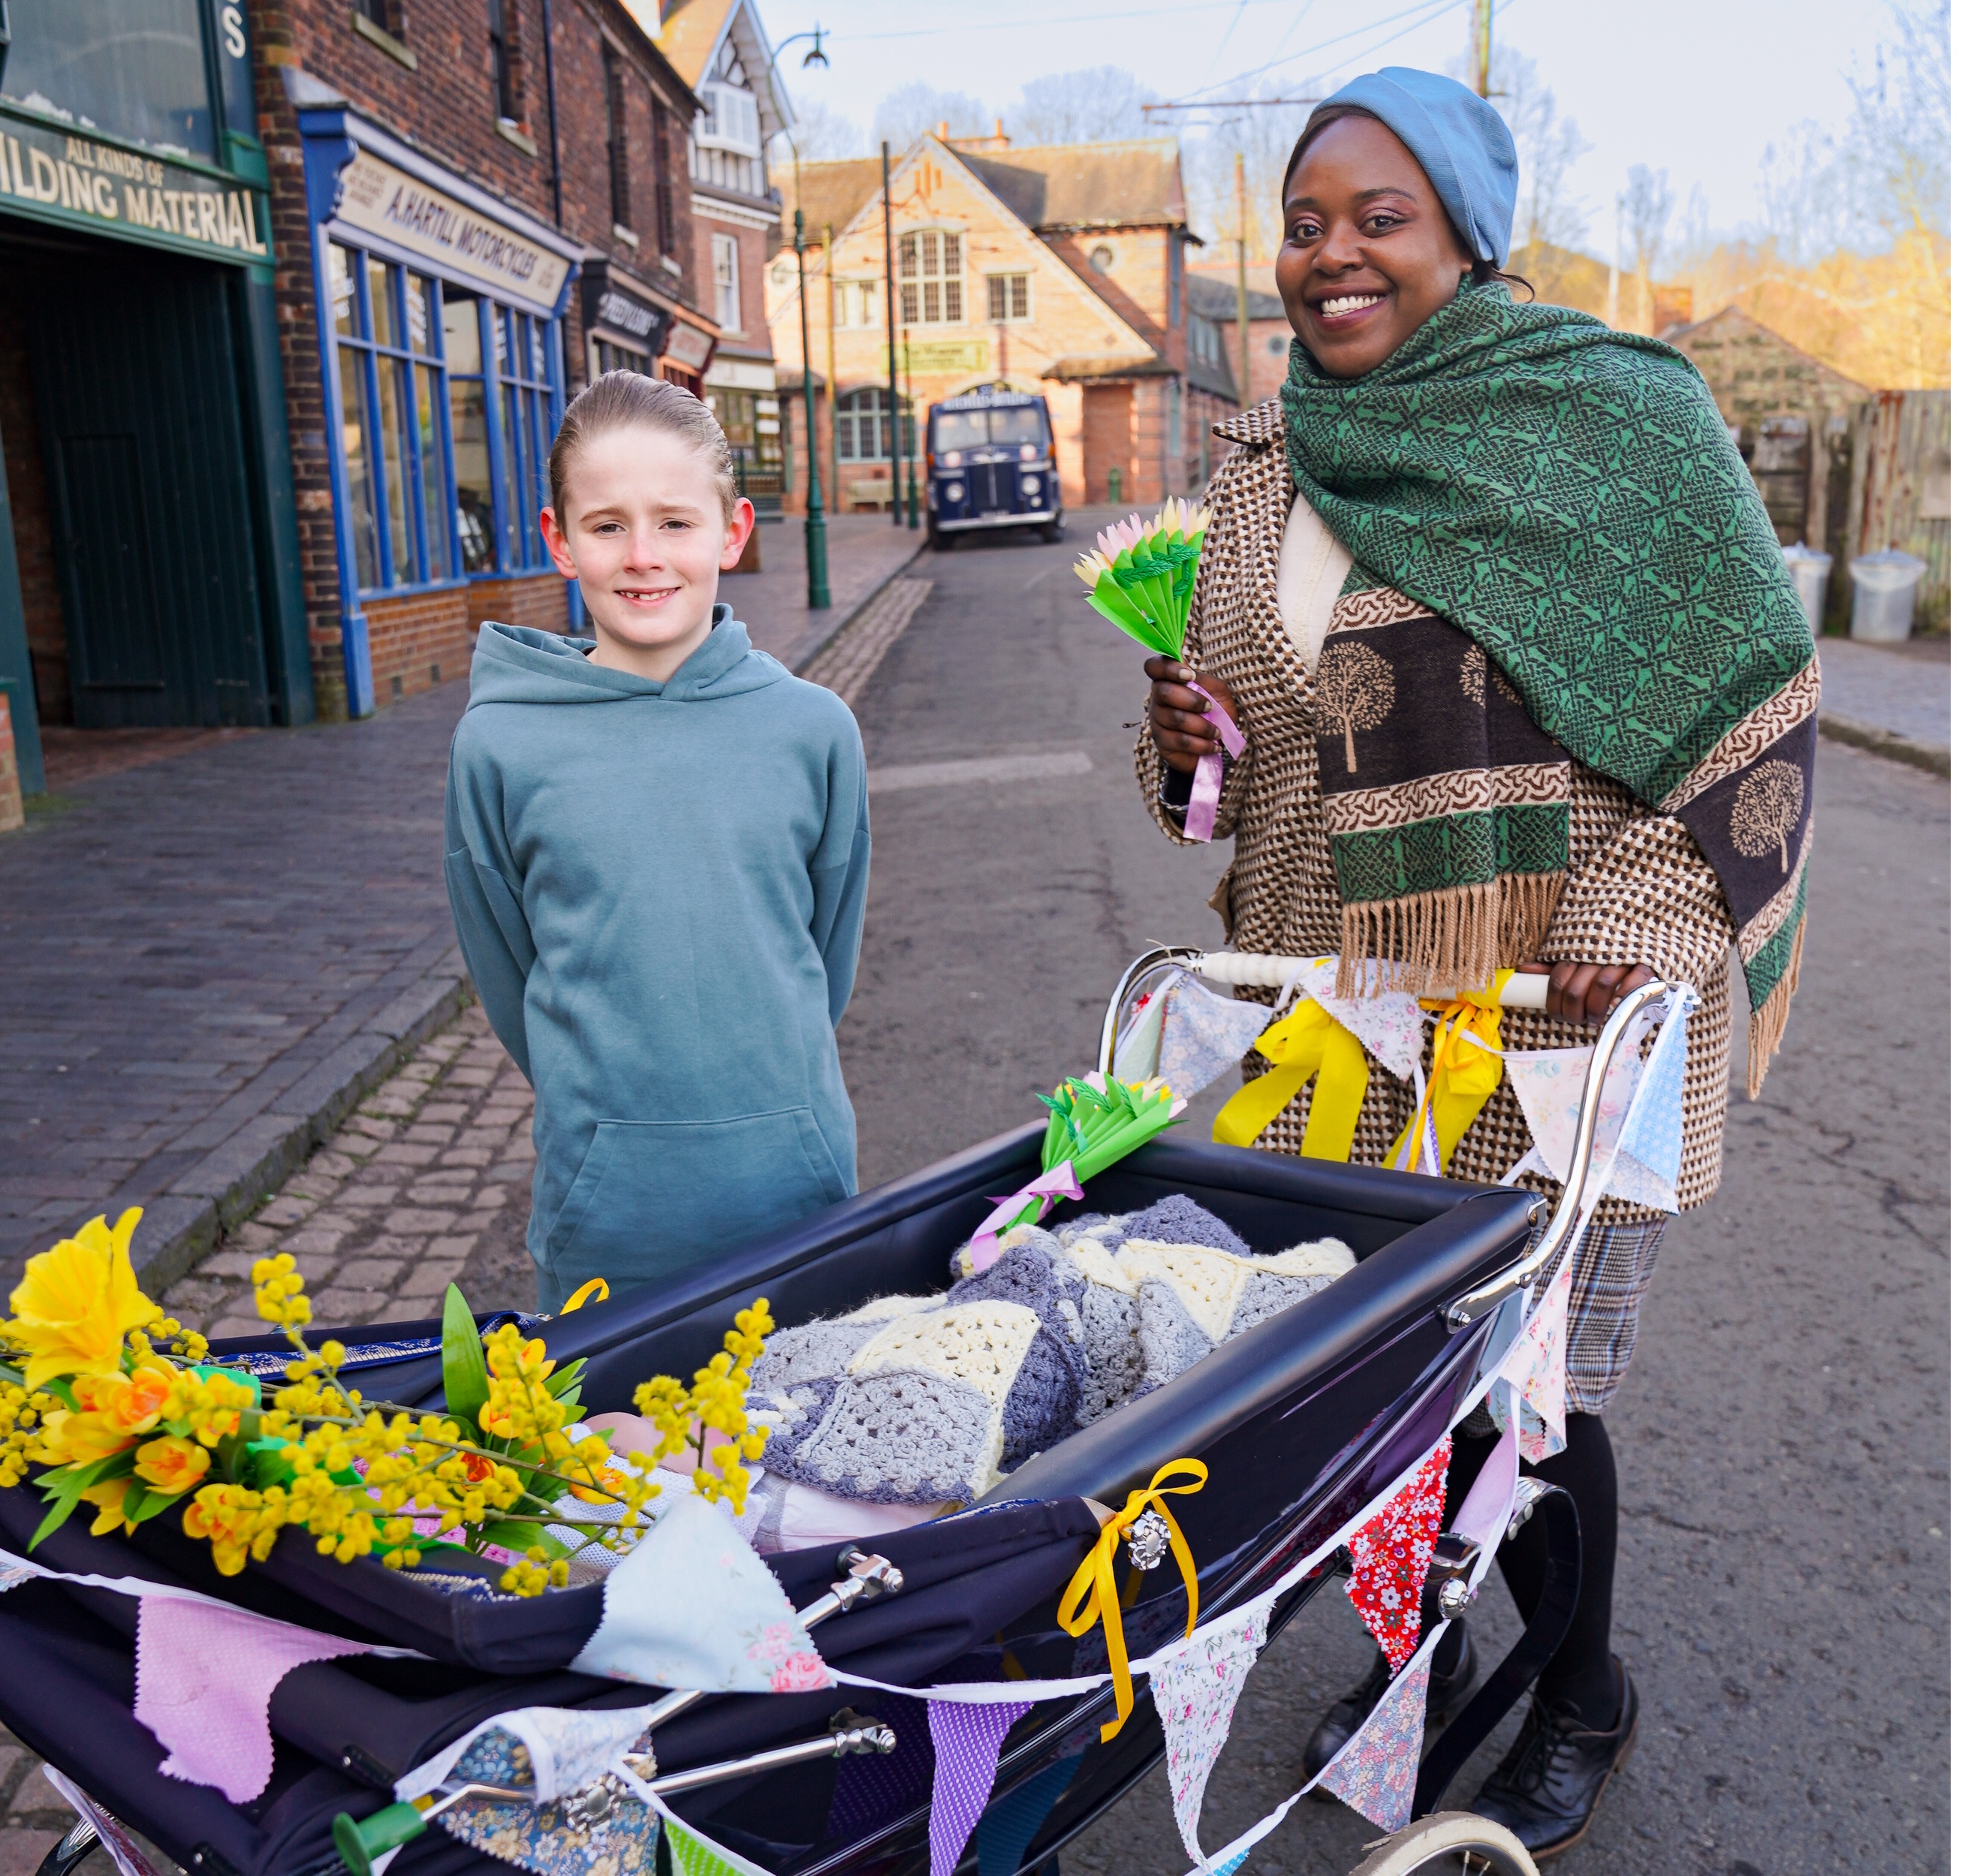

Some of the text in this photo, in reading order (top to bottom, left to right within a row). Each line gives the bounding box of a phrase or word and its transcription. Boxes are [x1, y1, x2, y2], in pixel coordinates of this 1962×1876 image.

[222, 0, 246, 59] S
[65, 135, 164, 188] ALL KINDS OF
[123, 184, 267, 256] MATERIAL
[456, 219, 539, 280] MOTORCYCLES
